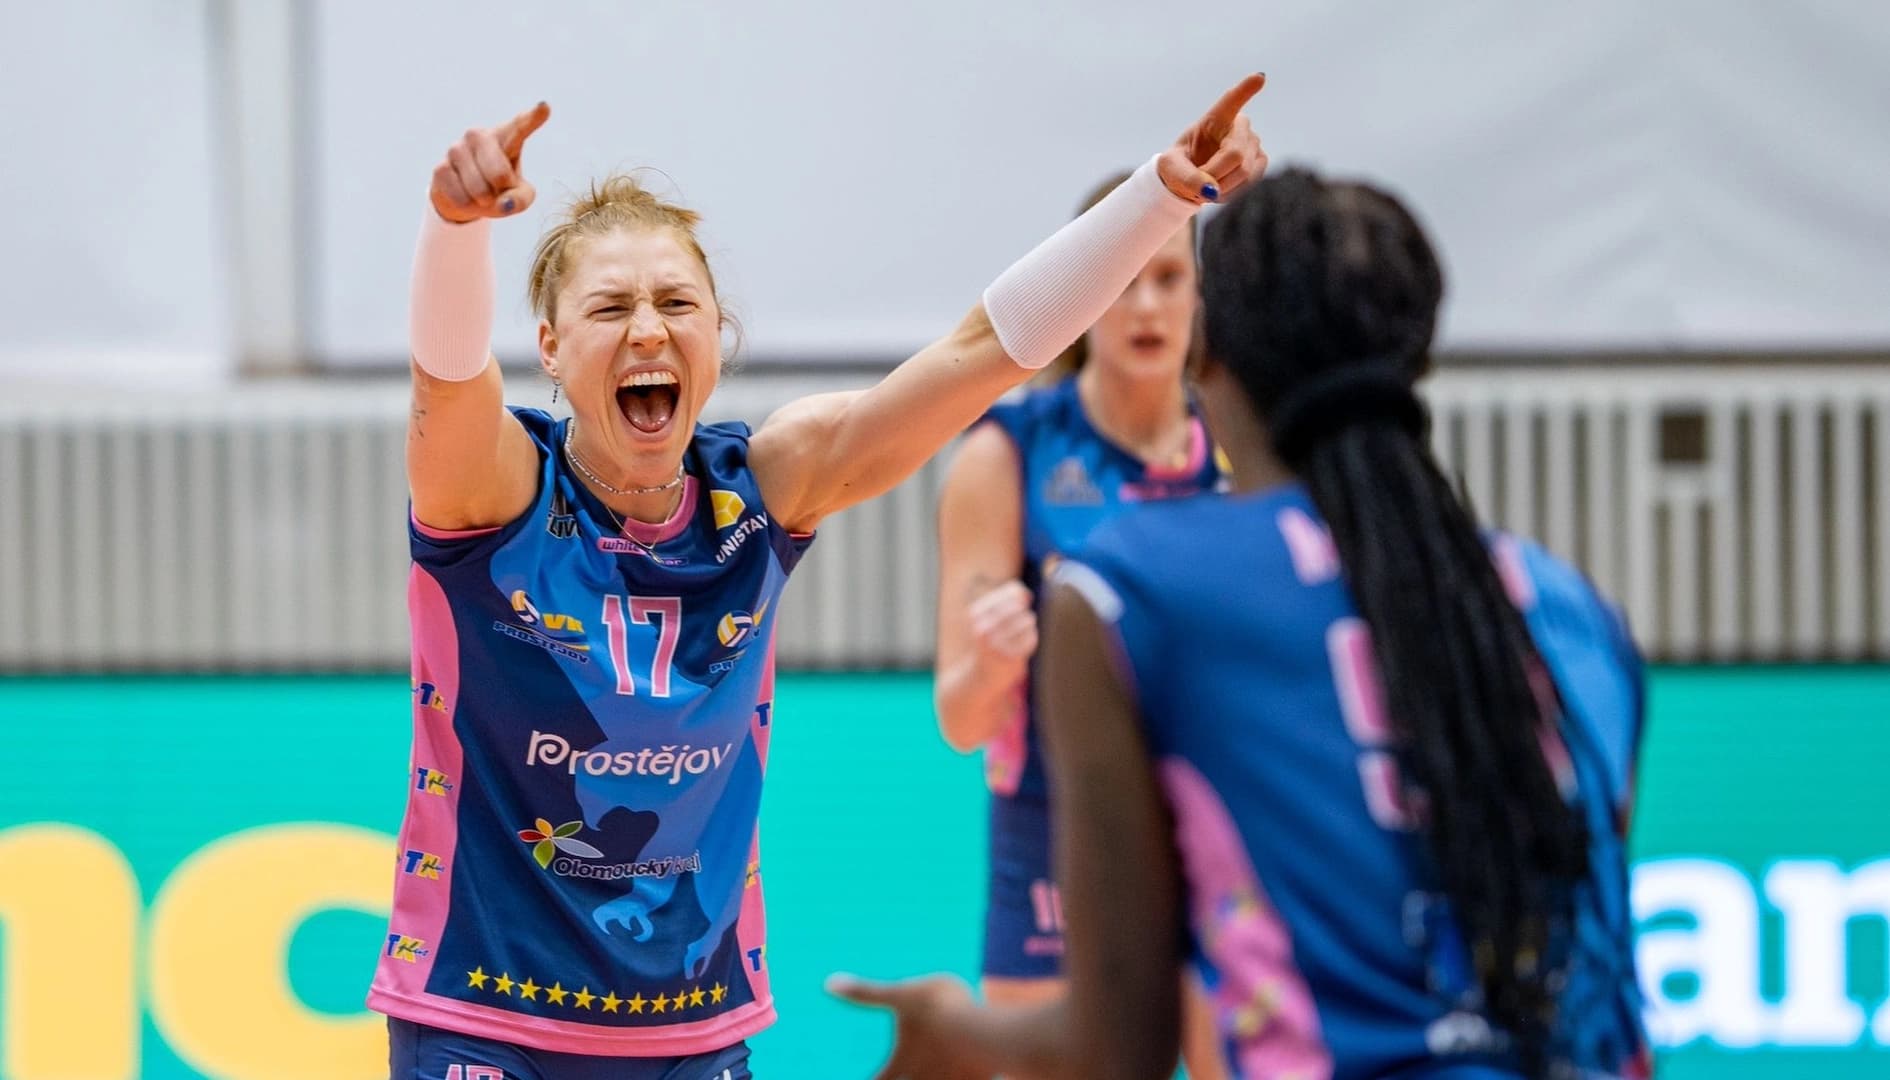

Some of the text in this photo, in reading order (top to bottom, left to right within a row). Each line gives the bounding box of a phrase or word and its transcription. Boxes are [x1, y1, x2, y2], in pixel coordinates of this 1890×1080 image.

[715, 511, 769, 564] UNISTAV
[602, 595, 682, 697] 17
[526, 730, 732, 784] Prostějov
[553, 857, 671, 880] Olomoucký
